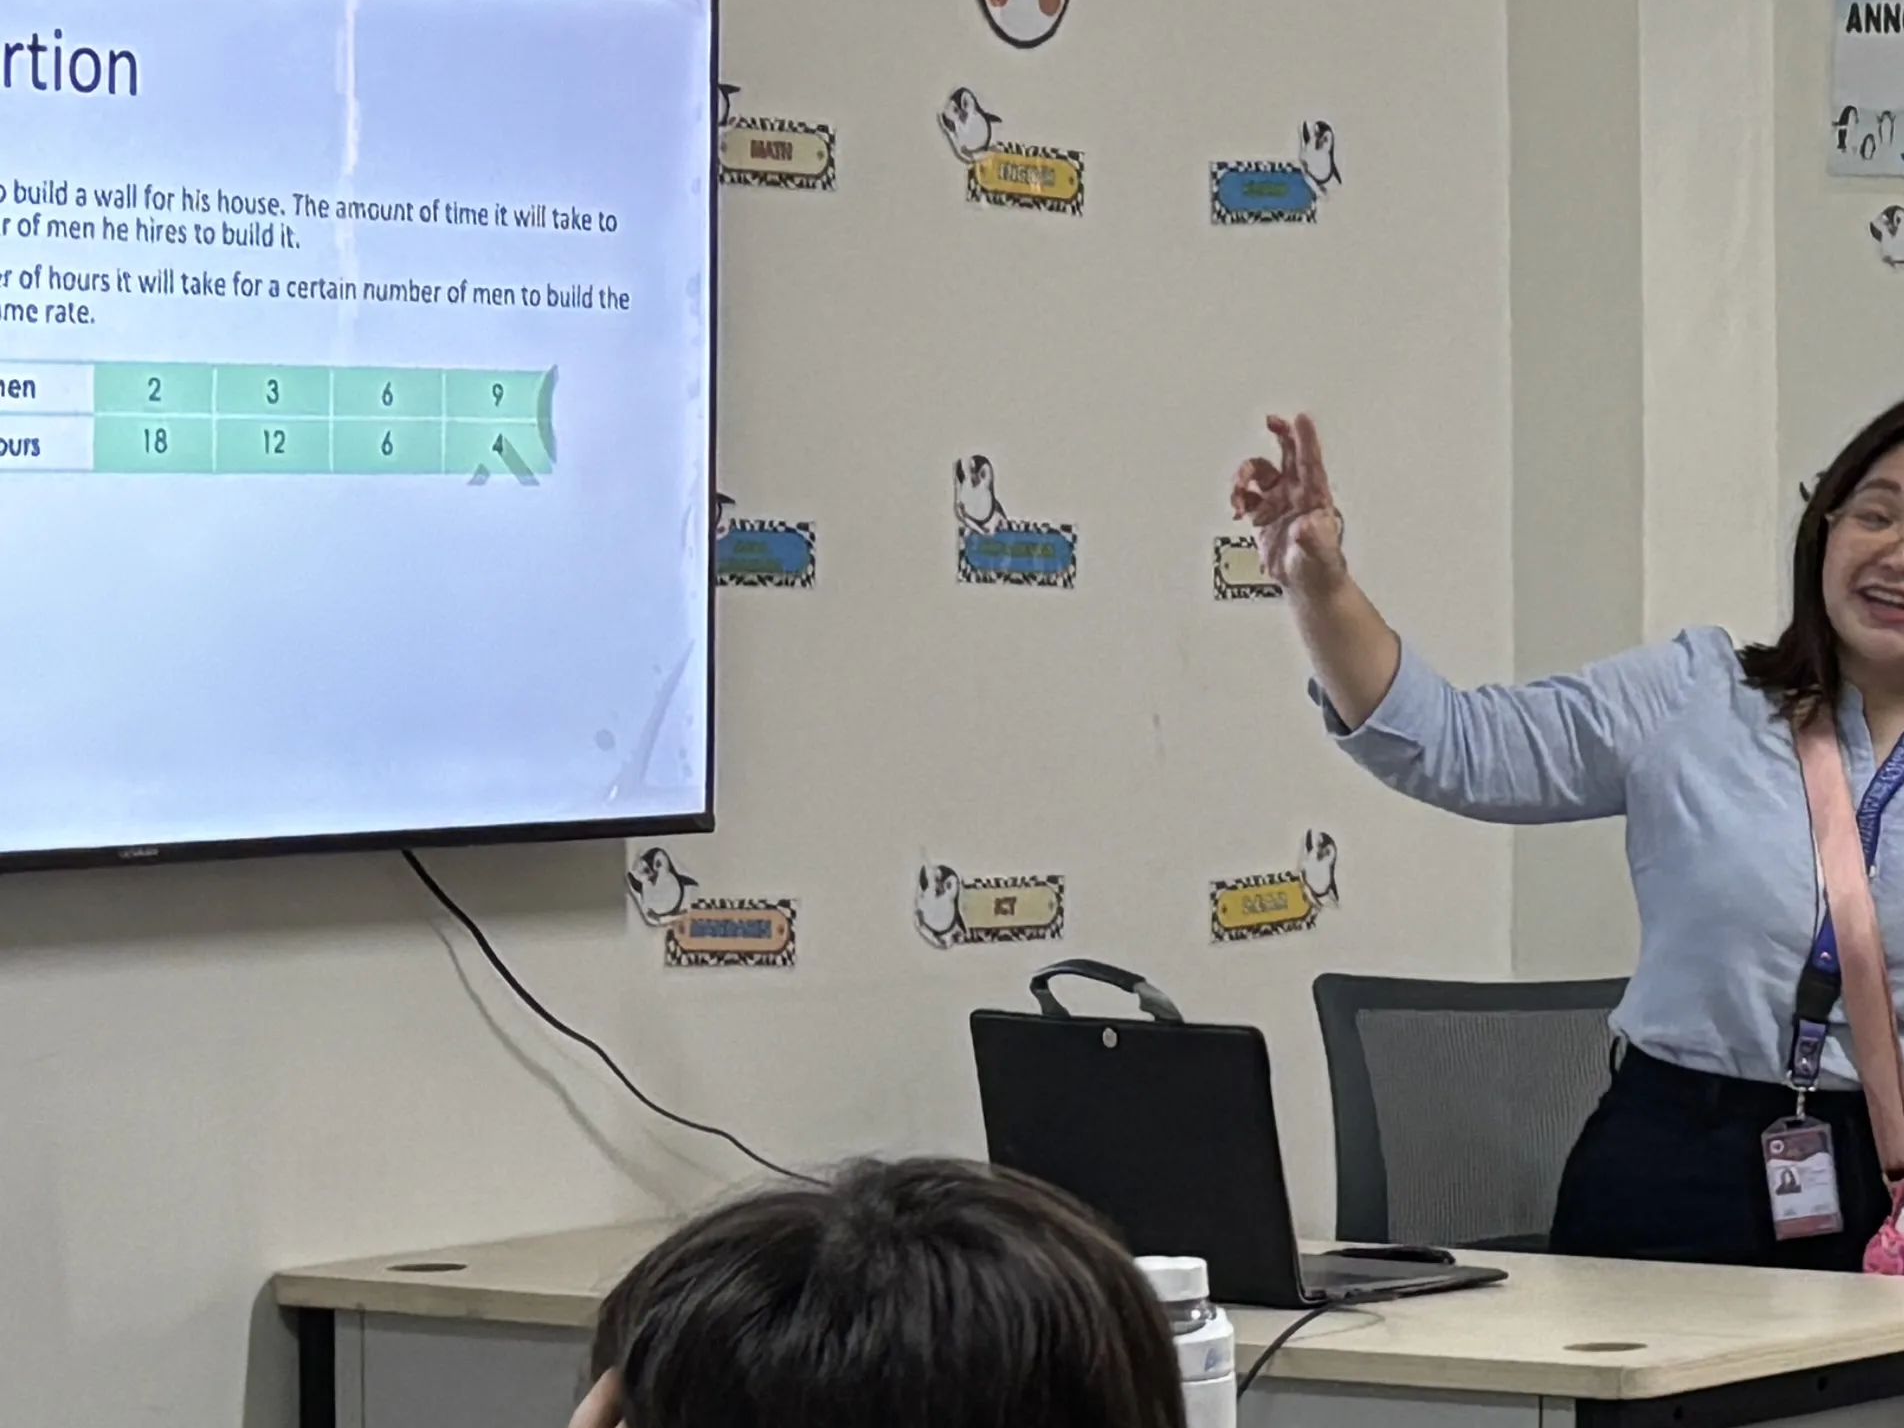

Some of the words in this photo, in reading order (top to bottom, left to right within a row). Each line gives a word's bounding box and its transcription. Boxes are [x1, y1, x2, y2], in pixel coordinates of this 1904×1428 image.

[750, 139, 793, 161] MATH
[14, 179, 67, 206] build
[76, 187, 87, 207] a
[95, 184, 137, 209] wall
[144, 184, 175, 212] for
[182, 186, 210, 212] his
[218, 189, 285, 216] house.
[293, 193, 329, 218] The
[336, 201, 413, 222] amount
[420, 198, 439, 223] of
[445, 202, 488, 226] time
[495, 203, 508, 227] it
[514, 204, 546, 228] will
[552, 206, 592, 230] take
[599, 211, 617, 232] to
[18, 212, 41, 237] of
[47, 219, 95, 239] men
[103, 216, 128, 241] he
[136, 217, 187, 244] hires
[195, 224, 215, 245] to
[222, 221, 273, 247] build
[281, 223, 300, 249] it.
[19, 264, 42, 289] of
[49, 265, 110, 292] hours
[117, 268, 131, 293] it
[139, 268, 174, 294] will
[181, 271, 226, 296] take
[233, 271, 262, 297] for
[269, 279, 279, 297] a
[287, 277, 356, 300] certain
[363, 278, 441, 303] number
[448, 279, 467, 303] of
[473, 286, 515, 305] men
[521, 286, 541, 306] to
[547, 283, 593, 308] build
[599, 286, 629, 310] the
[0, 303, 38, 322] me
[46, 303, 95, 324] rate.
[148, 377, 161, 402] 2
[267, 380, 279, 404] 3
[381, 382, 393, 405] 6
[492, 383, 503, 407] 9
[144, 428, 167, 453] 18
[264, 430, 285, 454] 12
[381, 431, 393, 455] 6
